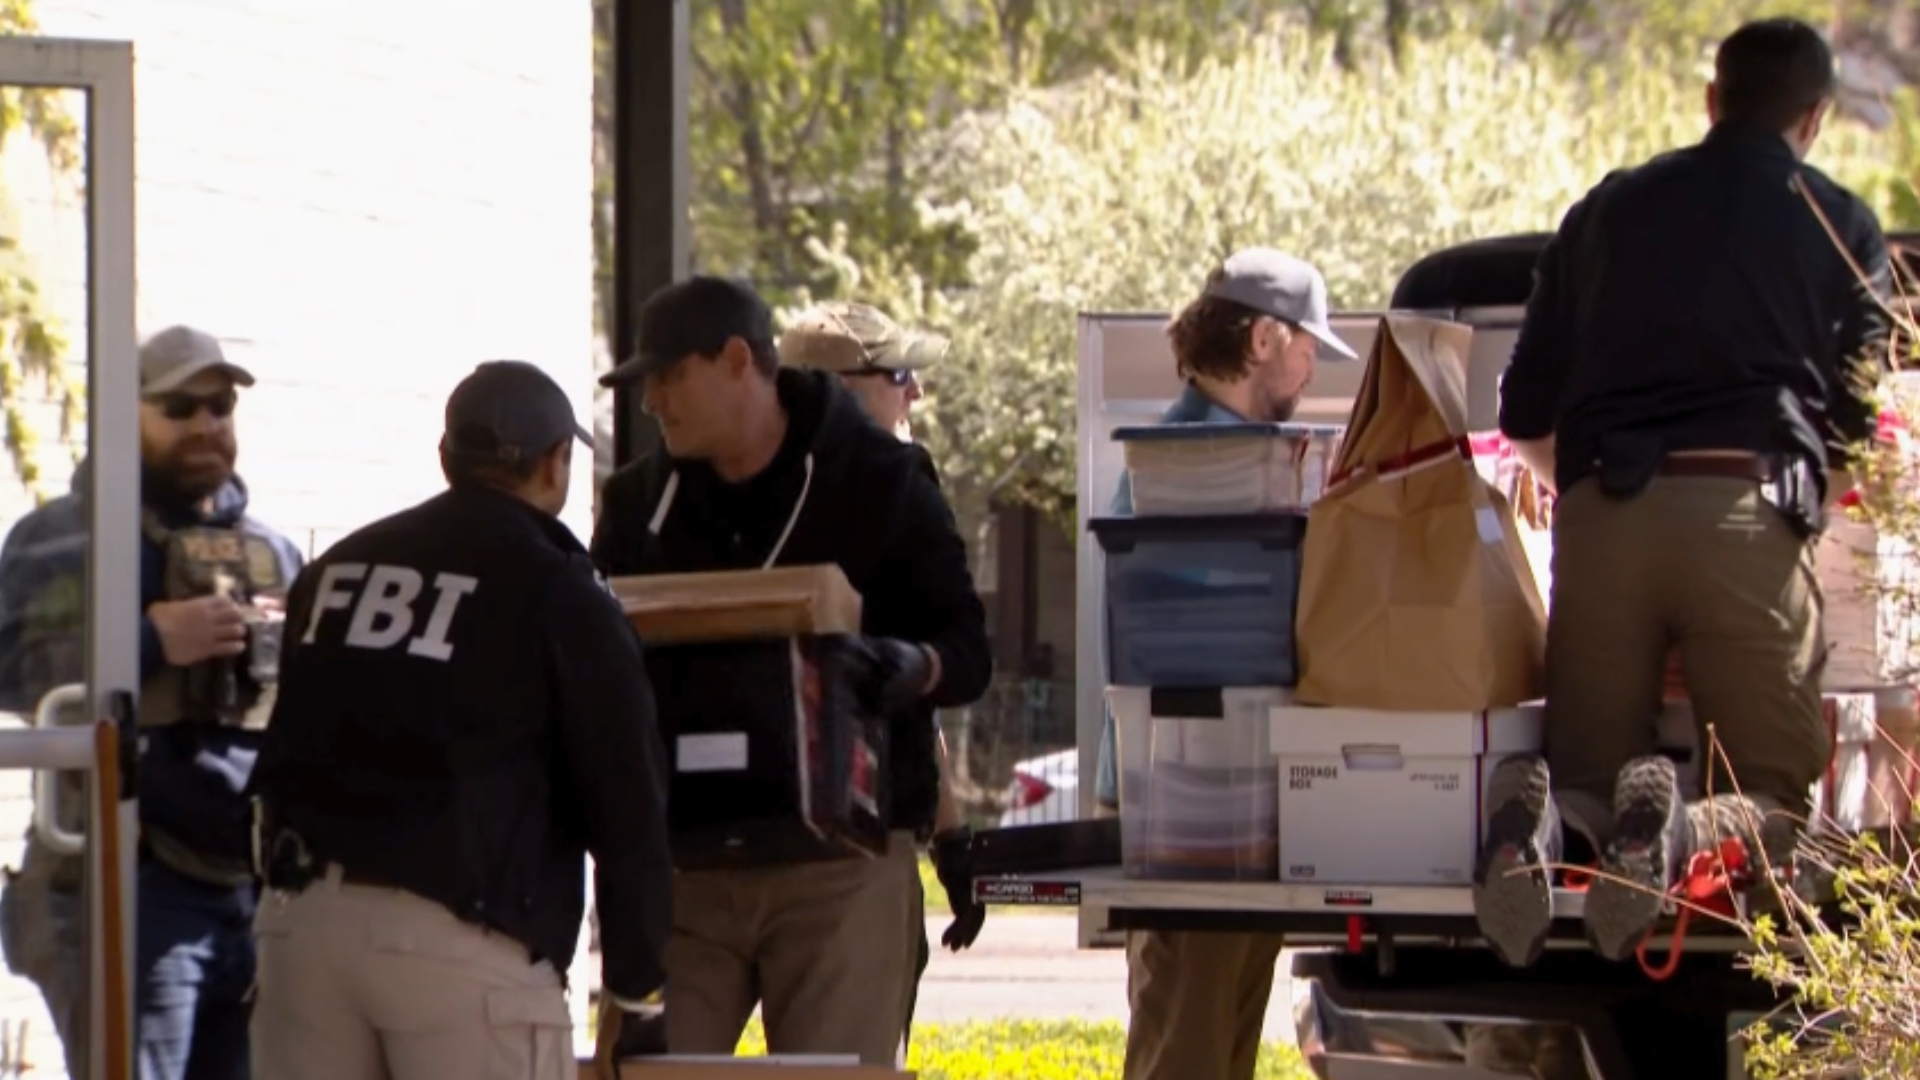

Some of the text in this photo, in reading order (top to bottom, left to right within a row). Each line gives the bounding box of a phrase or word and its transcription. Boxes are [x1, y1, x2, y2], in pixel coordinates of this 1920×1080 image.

[301, 562, 478, 662] FBI
[1289, 765, 1338, 780] STORAGE
[1289, 780, 1312, 790] BOX
